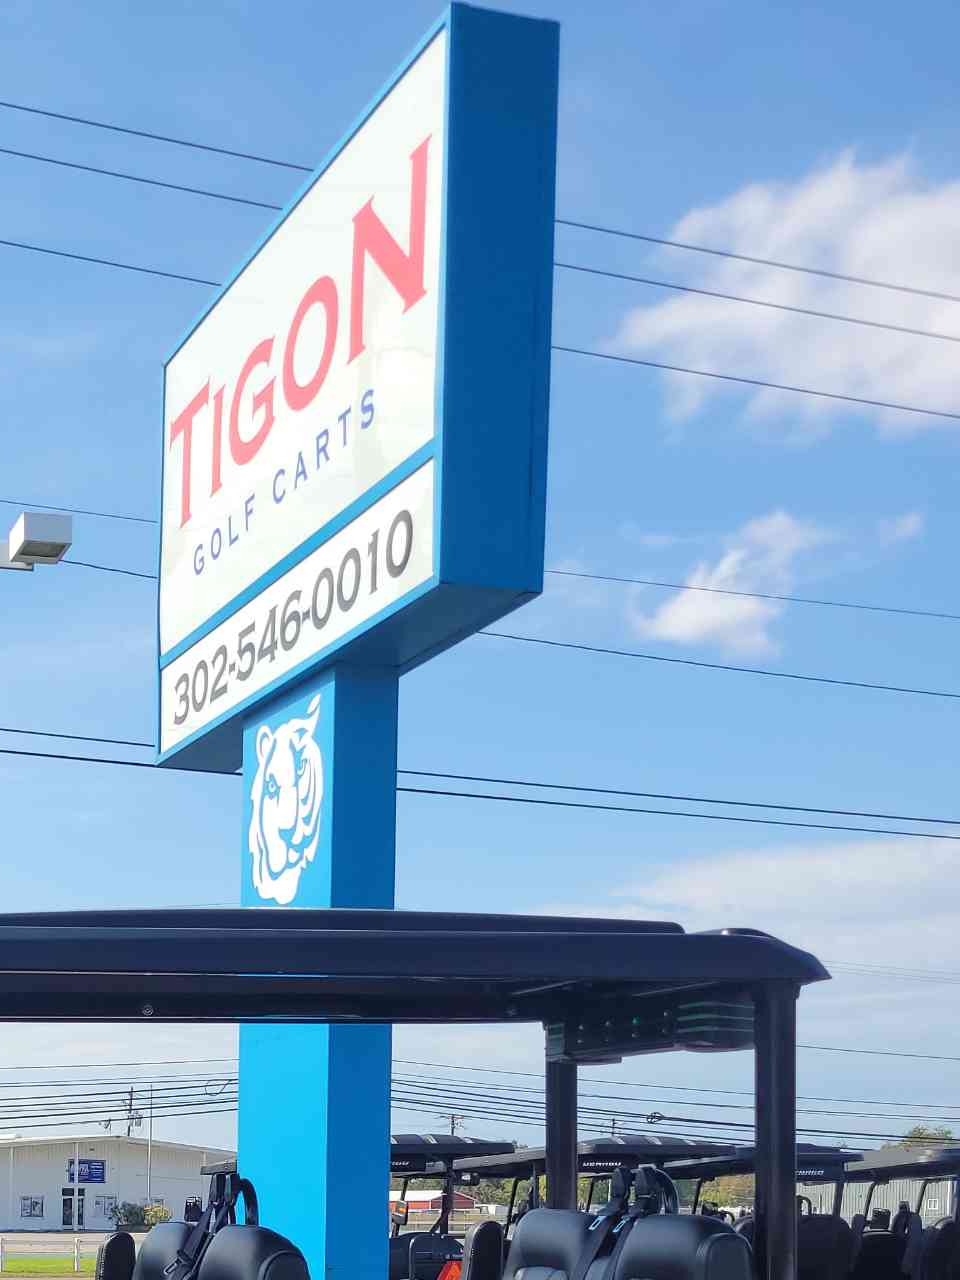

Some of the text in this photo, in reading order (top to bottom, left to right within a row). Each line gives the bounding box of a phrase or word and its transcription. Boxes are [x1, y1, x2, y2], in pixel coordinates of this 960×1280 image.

[170, 134, 432, 528] TIGON
[194, 389, 375, 575] GOLF CARTS
[173, 509, 414, 725] 302-546-0010
